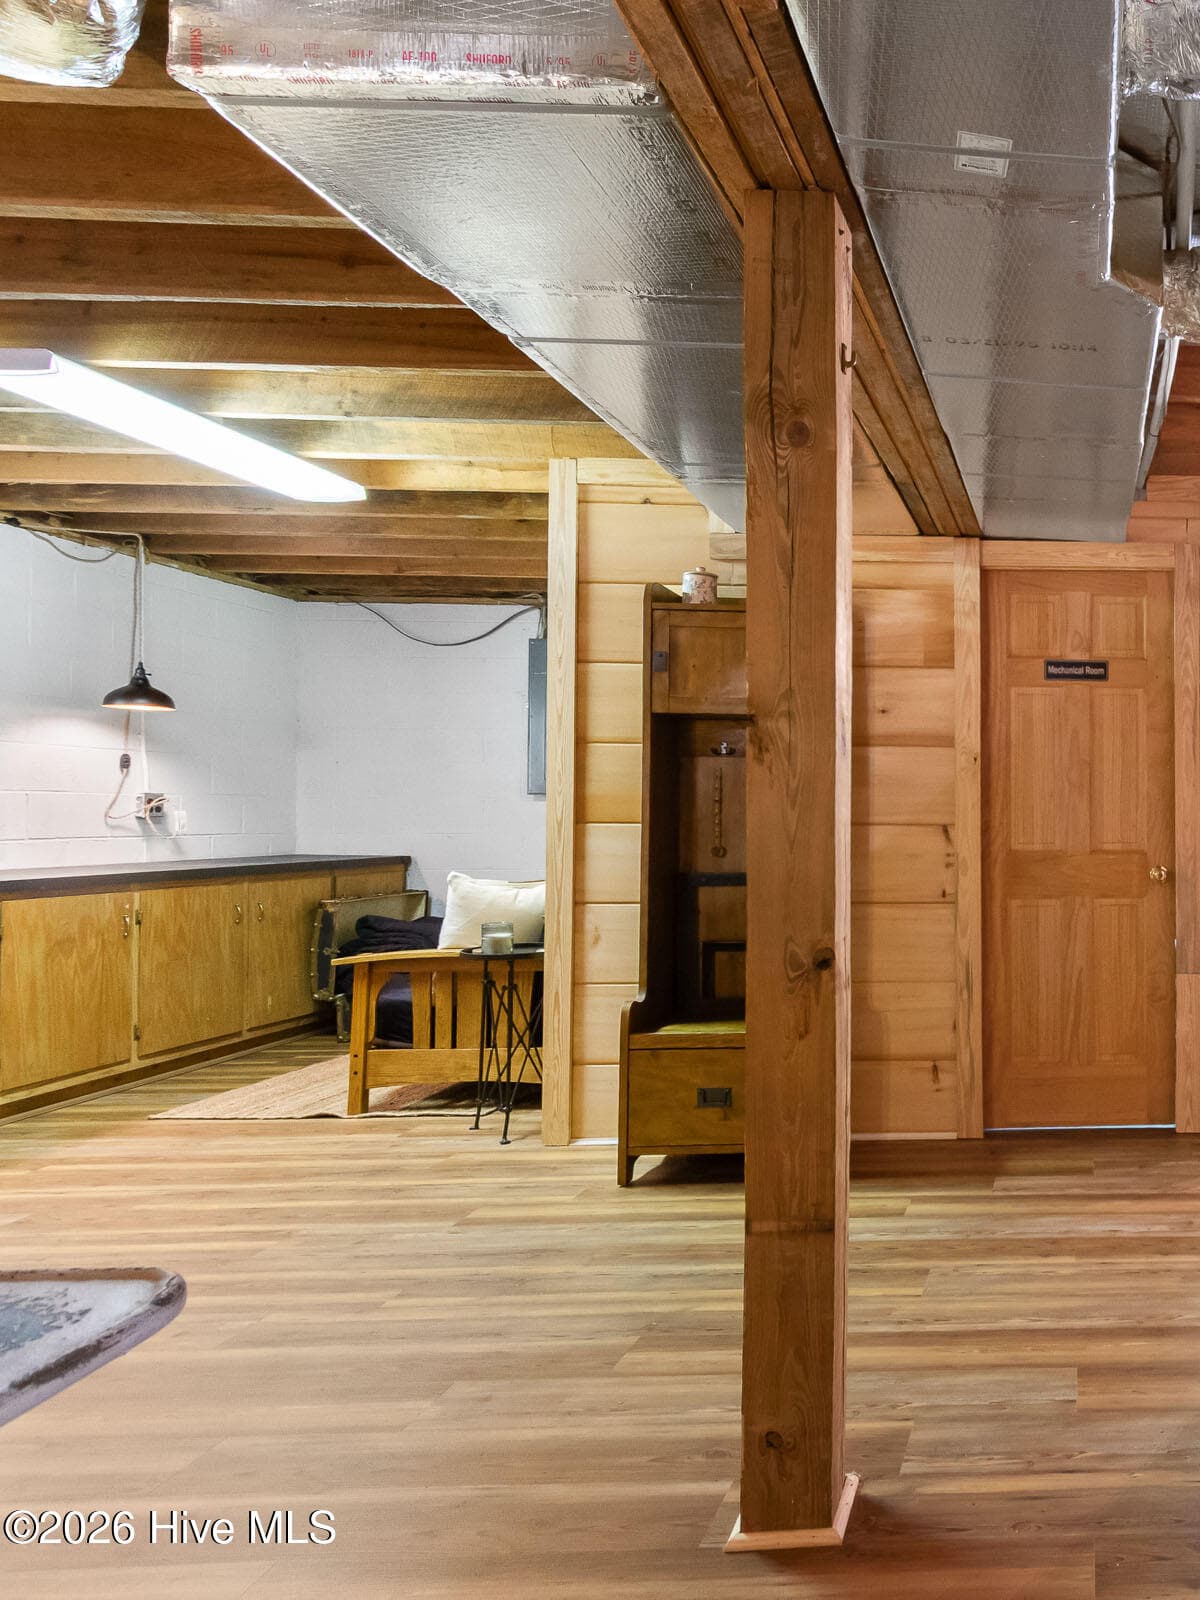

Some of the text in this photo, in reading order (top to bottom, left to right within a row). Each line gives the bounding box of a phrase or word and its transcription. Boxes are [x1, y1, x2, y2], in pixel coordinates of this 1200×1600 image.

[465, 52, 512, 65] SHUFORD
[1047, 665, 1105, 675] Mechanical Room
